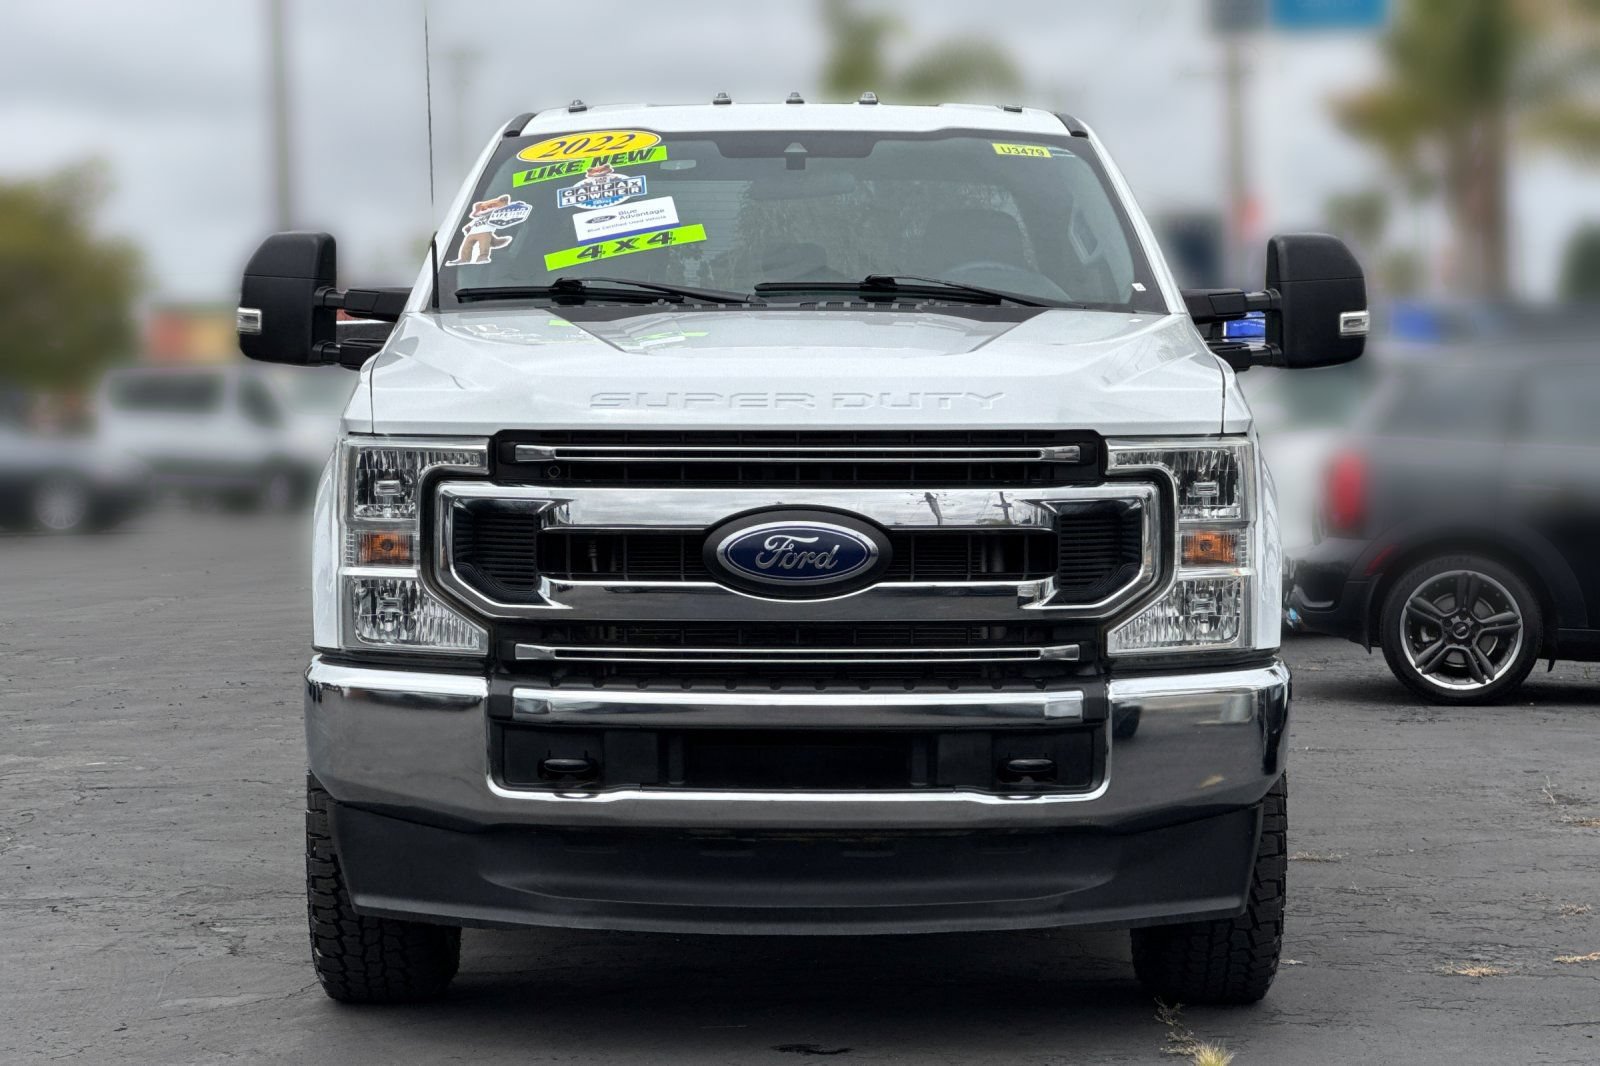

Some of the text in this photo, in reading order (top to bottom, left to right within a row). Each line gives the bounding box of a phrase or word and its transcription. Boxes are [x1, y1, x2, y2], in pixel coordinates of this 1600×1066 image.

[537, 133, 637, 159] 2022
[1001, 146, 1045, 156] U3479
[523, 147, 657, 183] LIKE NEW
[564, 180, 641, 197] CARFAX
[577, 186, 640, 202] OWNER
[618, 208, 637, 216] Blue
[619, 208, 665, 220] Advantage
[590, 392, 1006, 410] SUPER DUTY
[755, 534, 841, 571] Ford
